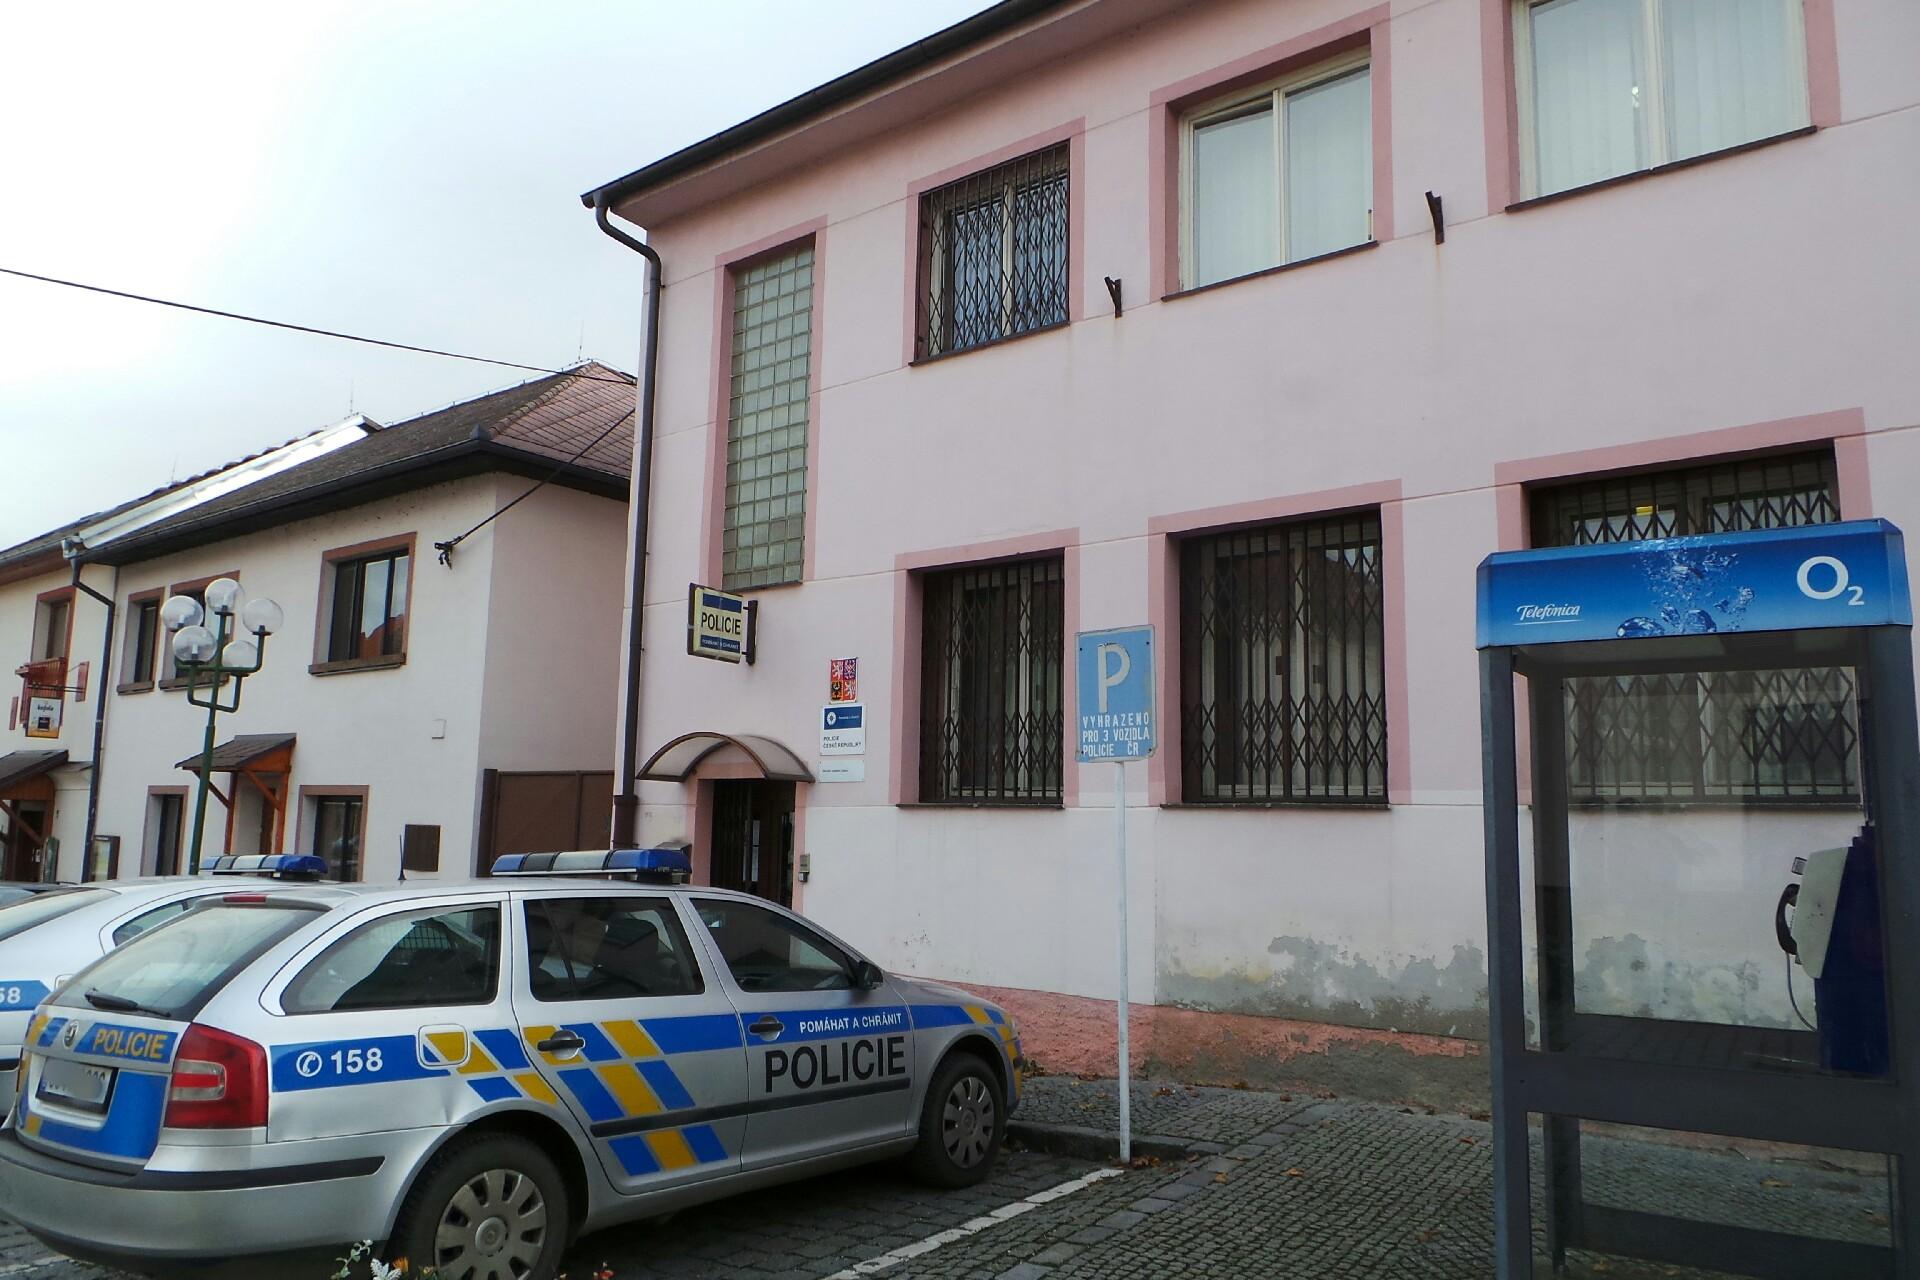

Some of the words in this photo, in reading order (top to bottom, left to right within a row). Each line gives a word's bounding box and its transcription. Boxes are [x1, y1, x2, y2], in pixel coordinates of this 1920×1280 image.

[1797, 555, 1865, 606] O2
[701, 612, 741, 635] POLICIE
[1098, 643, 1131, 713] P
[1082, 712, 1149, 728] VYHRAZENO
[1082, 730, 1099, 743] PRO
[1103, 730, 1109, 742] 3
[1113, 726, 1150, 742] VOZIDLA
[1082, 743, 1115, 757] POLICIE
[1127, 741, 1139, 756] ČR
[800, 1017, 850, 1034] POMÁHAT
[853, 1018, 860, 1028] A
[862, 1012, 902, 1028] CHRÁNIT
[93, 1028, 168, 1059] POLICIE
[331, 1047, 383, 1074] 158
[765, 1036, 906, 1093] POLICIE
